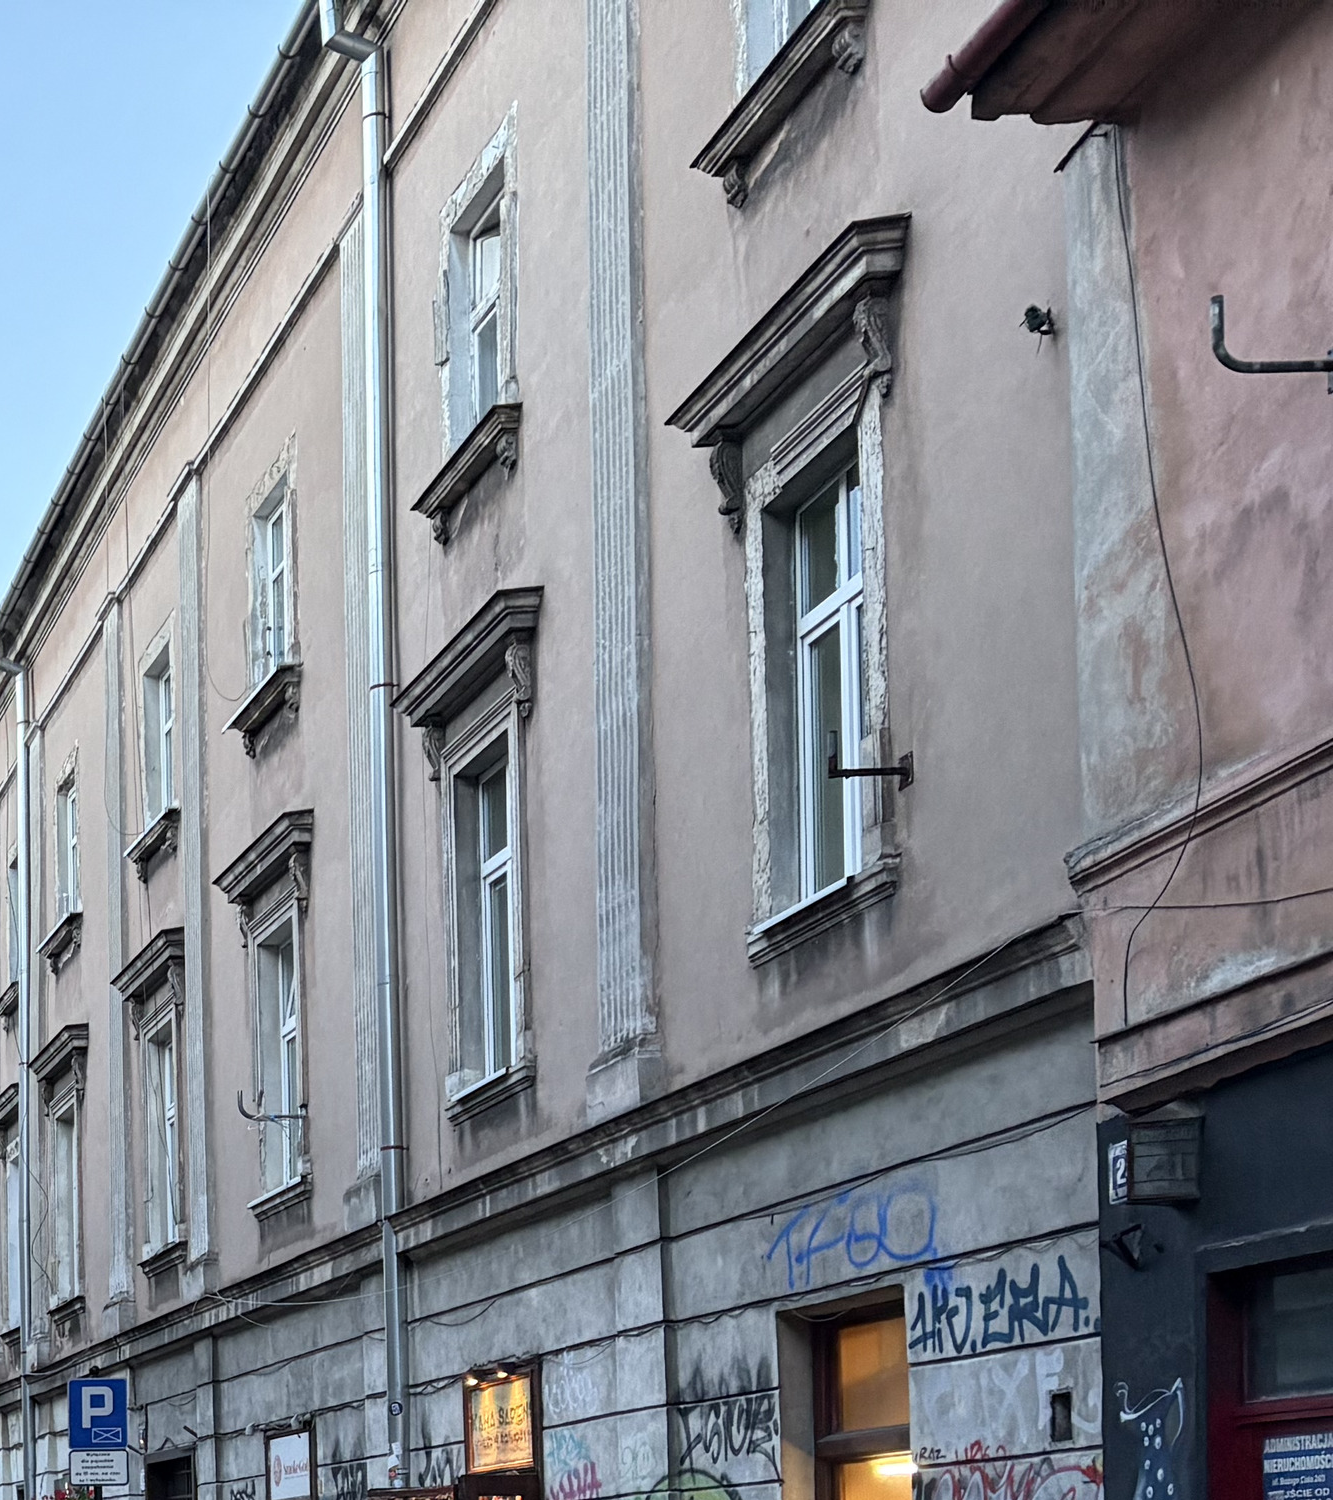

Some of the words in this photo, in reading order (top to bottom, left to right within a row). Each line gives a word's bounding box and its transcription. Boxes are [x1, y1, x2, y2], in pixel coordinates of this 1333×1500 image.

[82, 1386, 114, 1429] P
[1284, 1487, 1313, 1499] JŚCIE
[1314, 1487, 1330, 1497] OD
